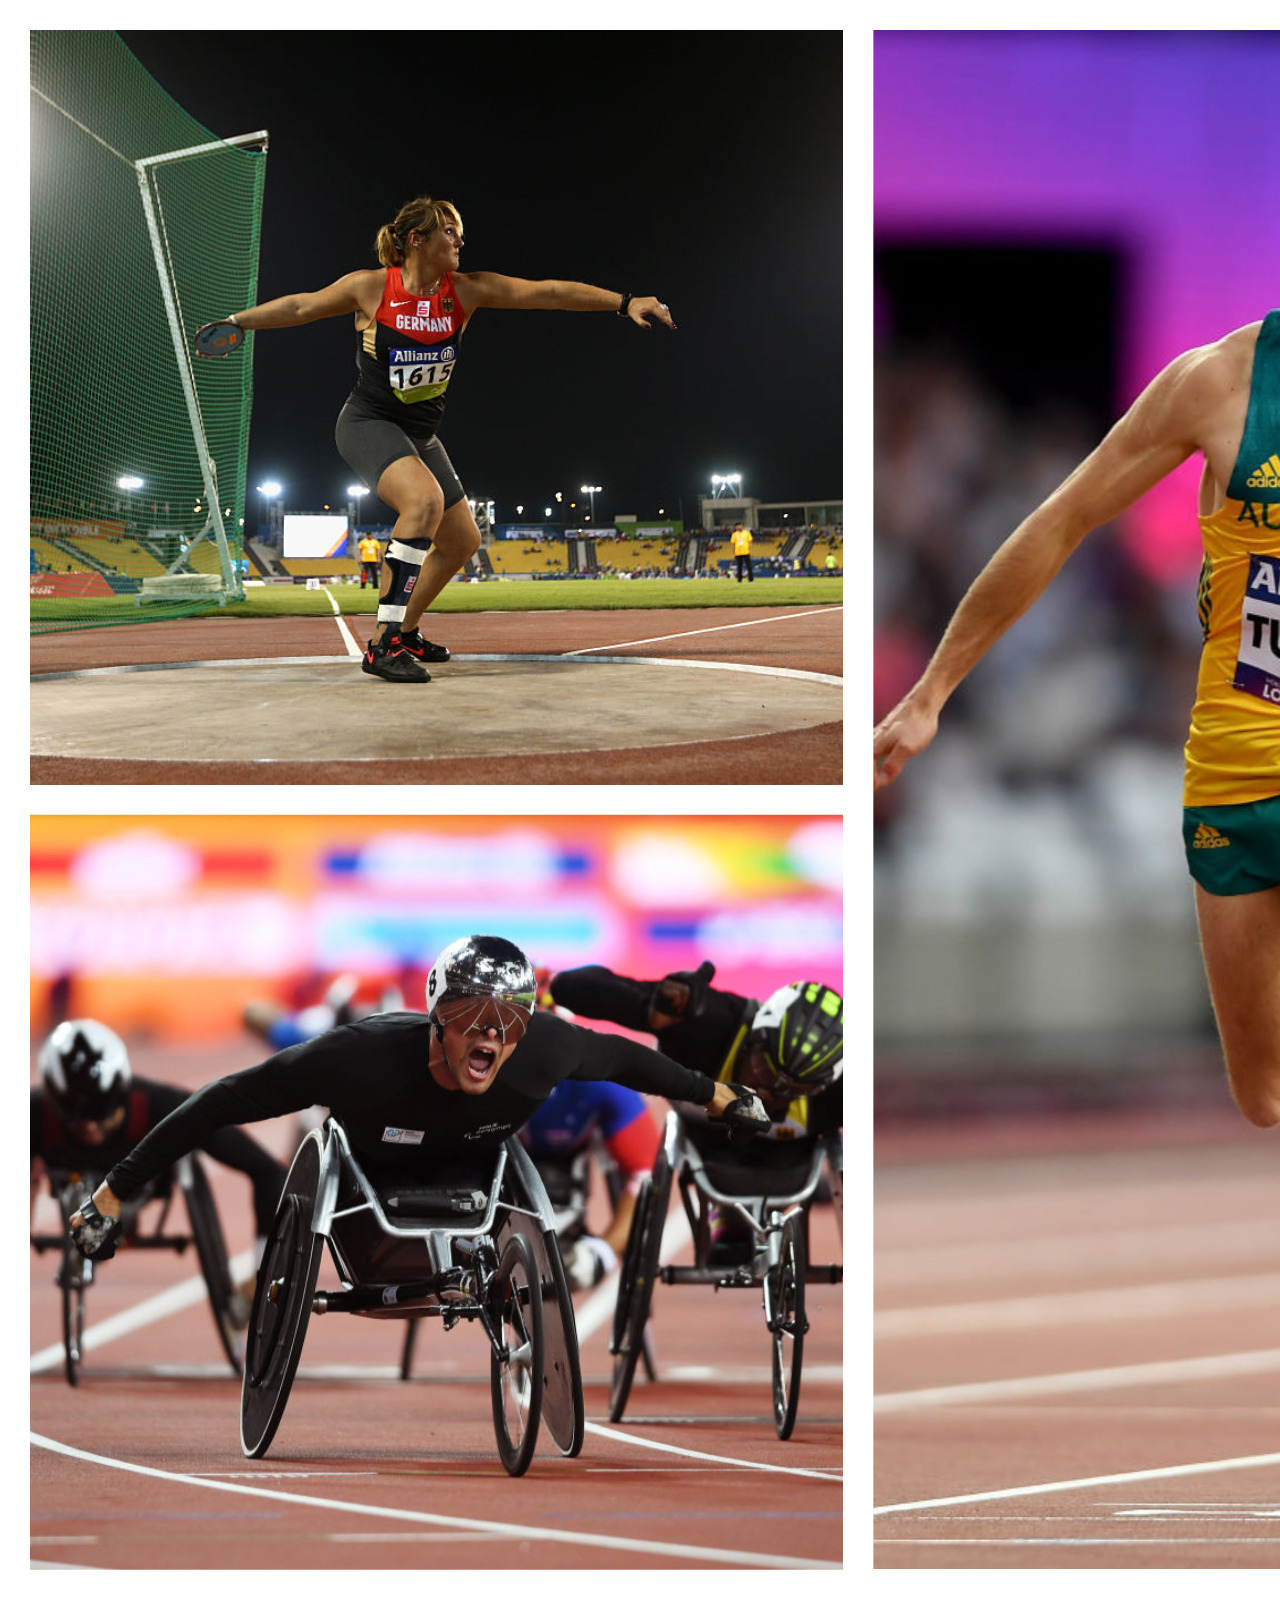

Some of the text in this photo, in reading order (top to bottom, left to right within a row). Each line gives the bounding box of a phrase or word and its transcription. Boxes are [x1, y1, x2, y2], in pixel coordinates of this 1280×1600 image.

[396, 314, 452, 332] GERMANY
[394, 350, 438, 362] Allianz
[394, 363, 453, 389] 1615
[1193, 837, 1230, 849] adidas
